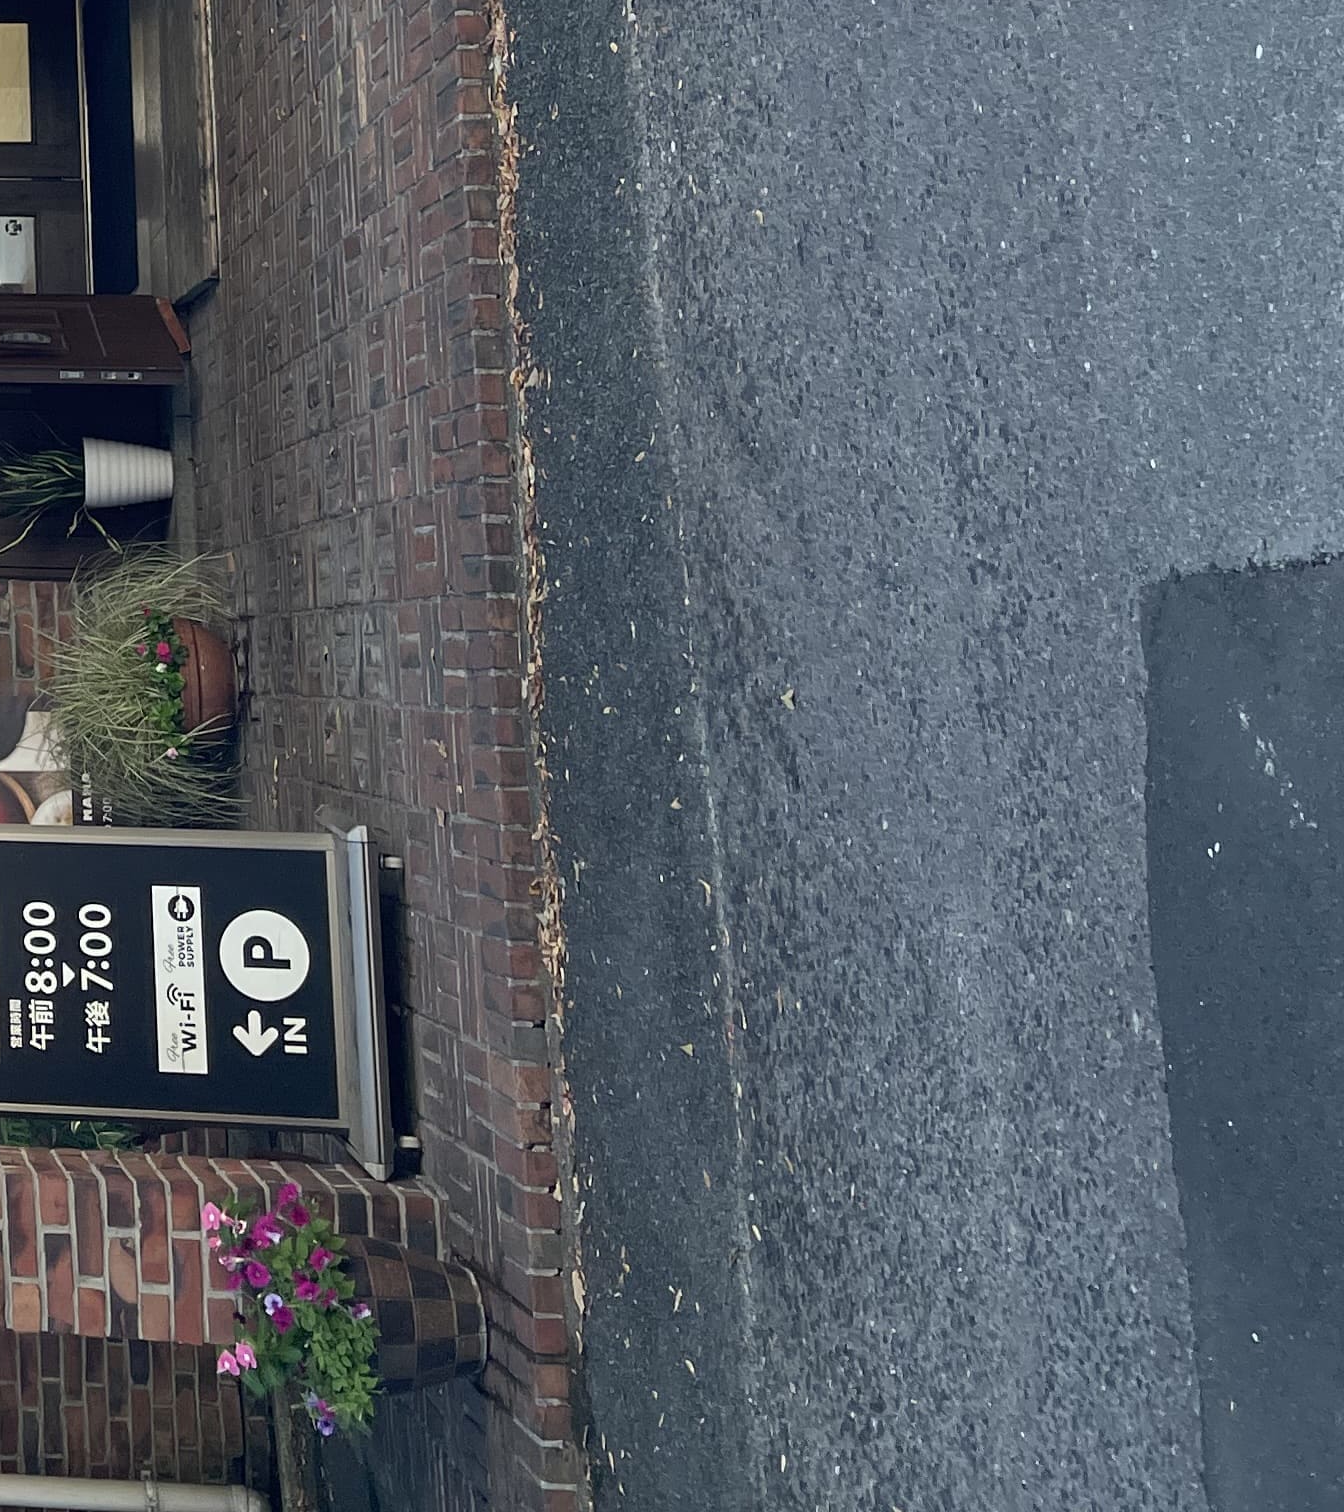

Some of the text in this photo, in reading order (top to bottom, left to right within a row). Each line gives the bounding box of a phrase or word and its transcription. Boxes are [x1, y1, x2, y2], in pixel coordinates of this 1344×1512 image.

[162, 943, 176, 973] Free
[177, 925, 186, 968] POWER
[185, 925, 195, 968] SUPPLY
[242, 935, 292, 970] P
[22, 901, 58, 1051] 午前 8:00
[78, 903, 114, 1054] 午後 7:00
[9, 998, 23, 1049] 営業時間
[177, 991, 197, 1053] Wi-Fi
[282, 1016, 308, 1055] IN
[166, 1032, 179, 1062] Free
